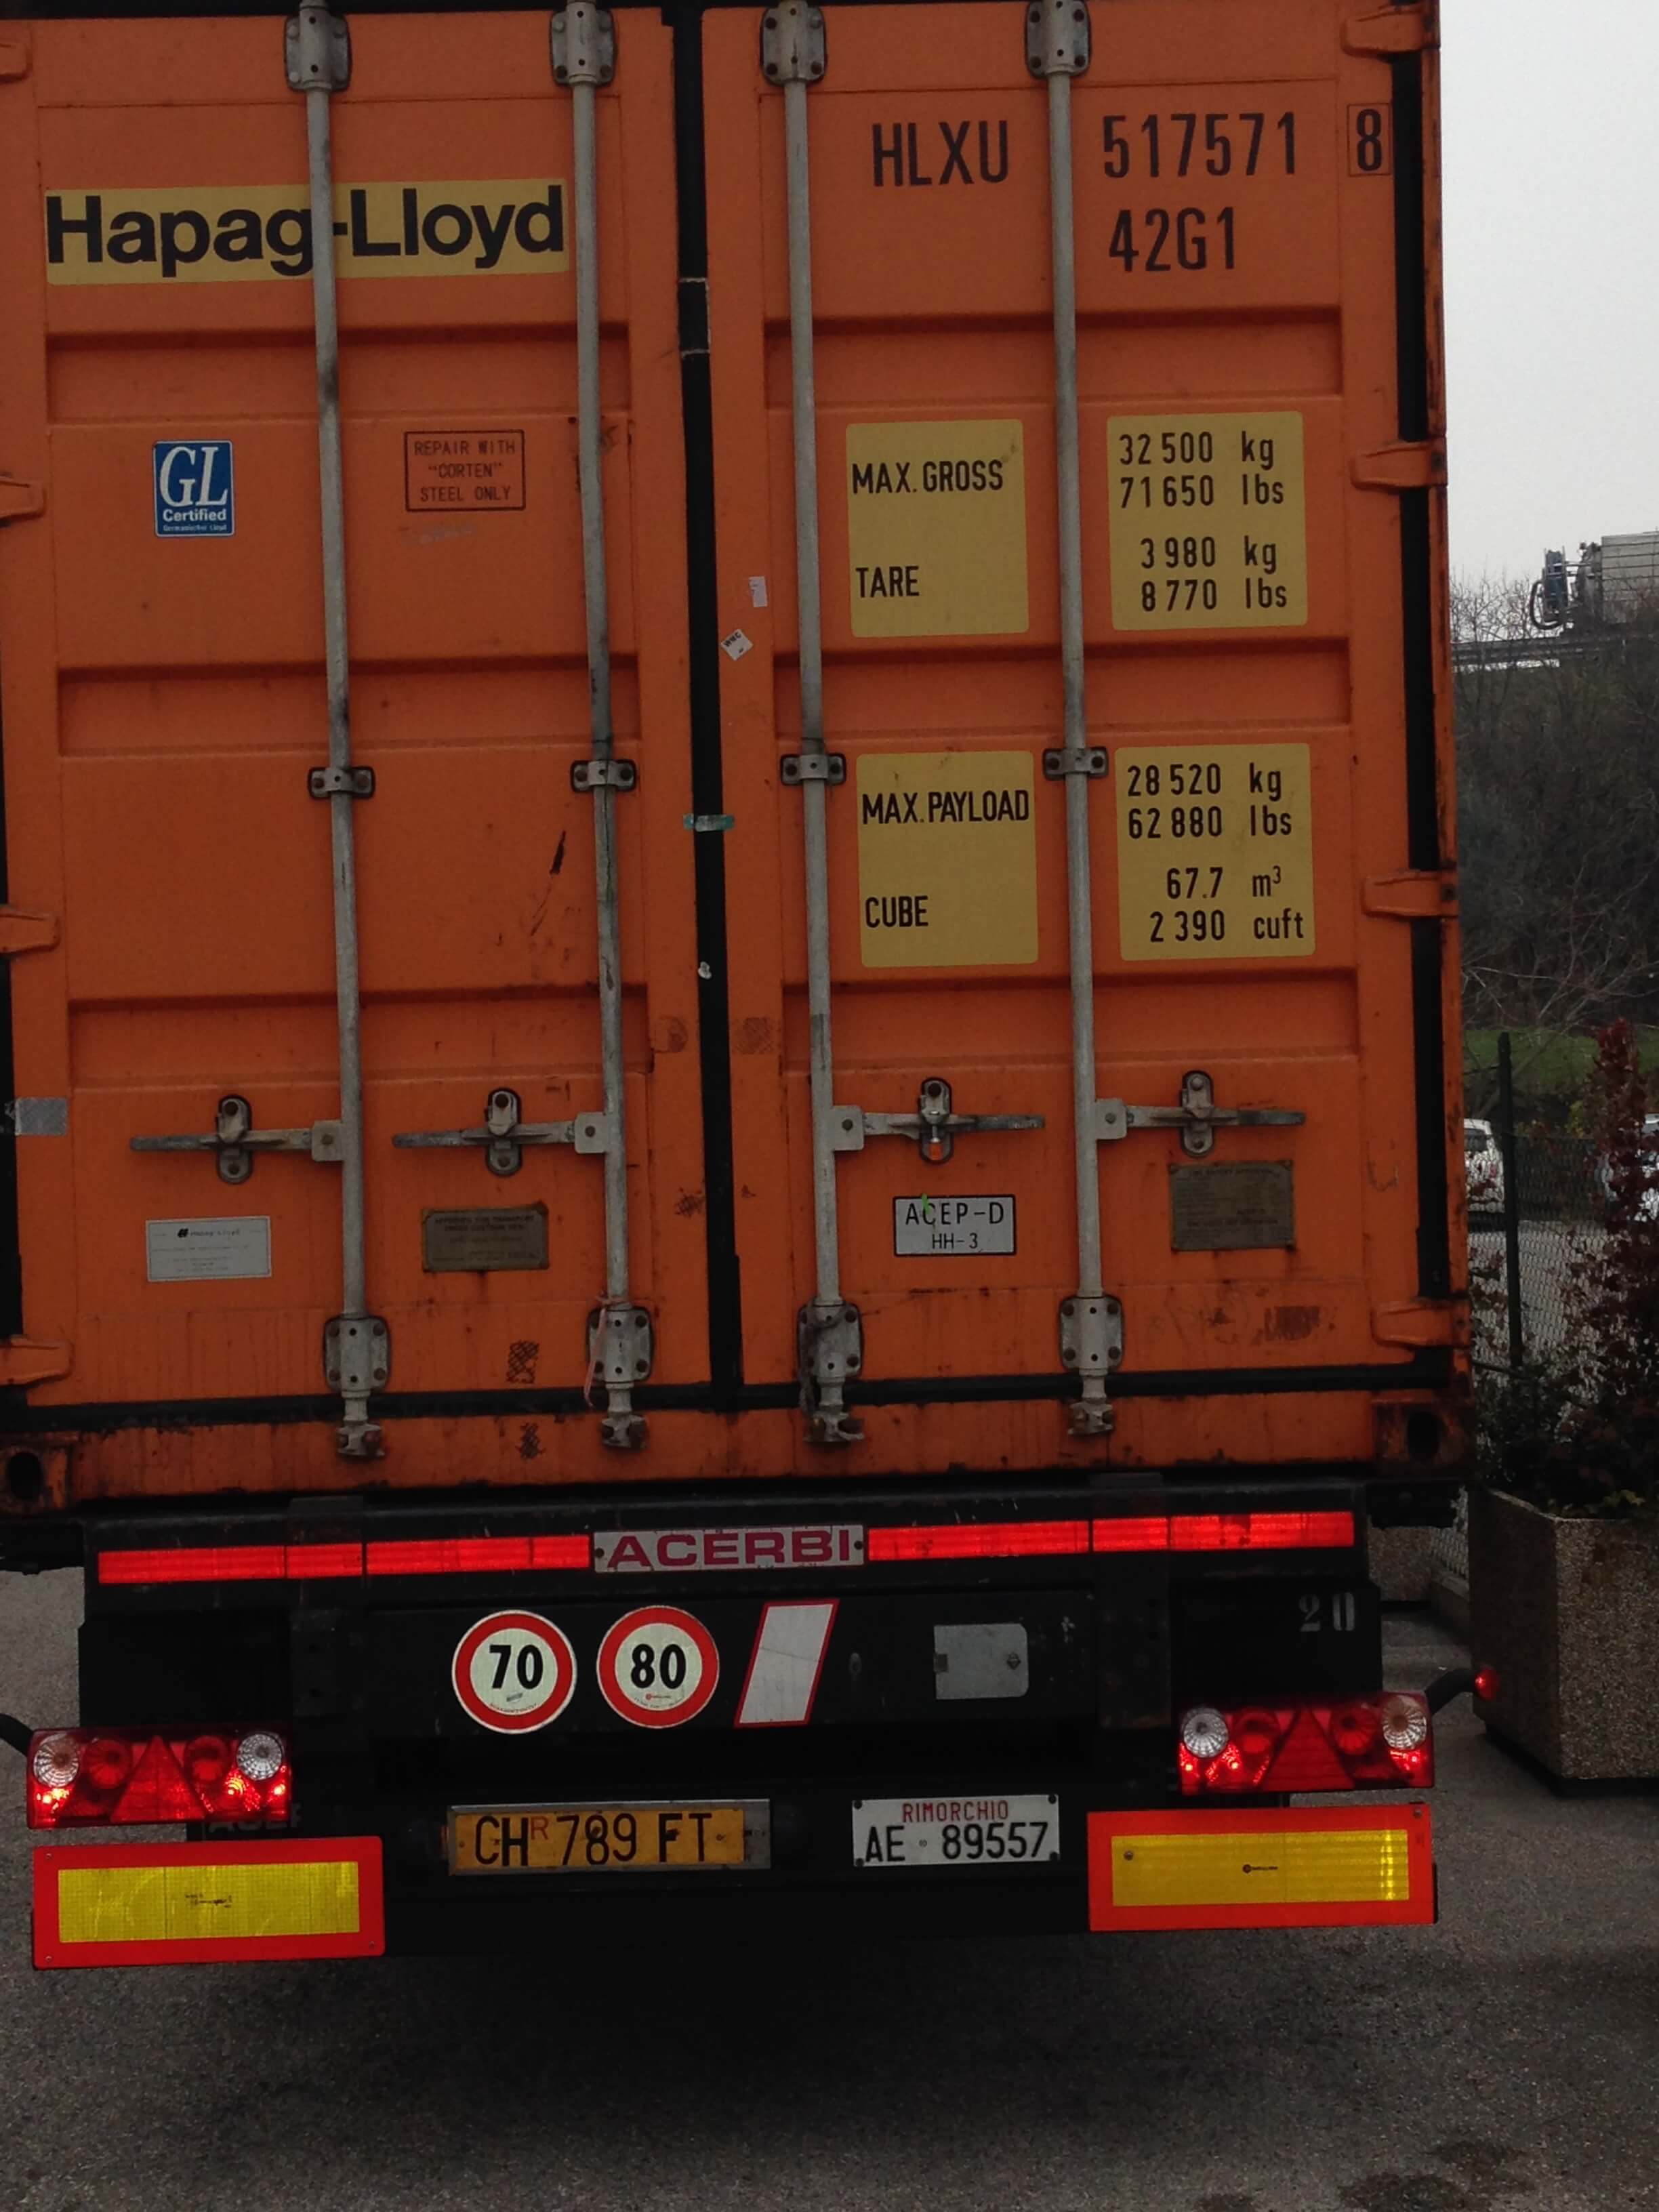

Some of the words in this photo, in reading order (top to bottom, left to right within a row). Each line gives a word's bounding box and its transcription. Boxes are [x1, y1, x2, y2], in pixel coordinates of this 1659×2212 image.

[872, 120, 1009, 187] HLXU
[1103, 112, 1296, 178] 517571
[1356, 108, 1383, 171] 8
[46, 184, 565, 278] Hapag-Lloyd
[1109, 207, 1235, 272] 42G1
[414, 441, 470, 455] REPAIR
[478, 440, 516, 455] WITH
[1241, 431, 1274, 469] kg
[160, 446, 228, 508] GL
[419, 485, 465, 502] STEEL
[474, 484, 511, 501] ONLY
[1242, 474, 1284, 506] lbs
[163, 508, 227, 522] Certified
[855, 566, 920, 598] TARE
[1244, 536, 1277, 574] kg
[1245, 577, 1287, 609] lbs
[1249, 762, 1282, 801] kg
[1249, 805, 1292, 836] lbs
[865, 895, 929, 928] CUBE
[1166, 867, 1224, 899] 67.7
[1253, 907, 1305, 940] cuft
[905, 1202, 1004, 1225] ACEP-D
[607, 1530, 850, 1569] ACERBI
[489, 1643, 544, 1689] 70
[630, 1643, 687, 1689] 80
[902, 1800, 1010, 1823] RIMORCHIO
[657, 1811, 713, 1864] FT
[865, 1824, 905, 1862] AE
[942, 1821, 1049, 1860] 89557
